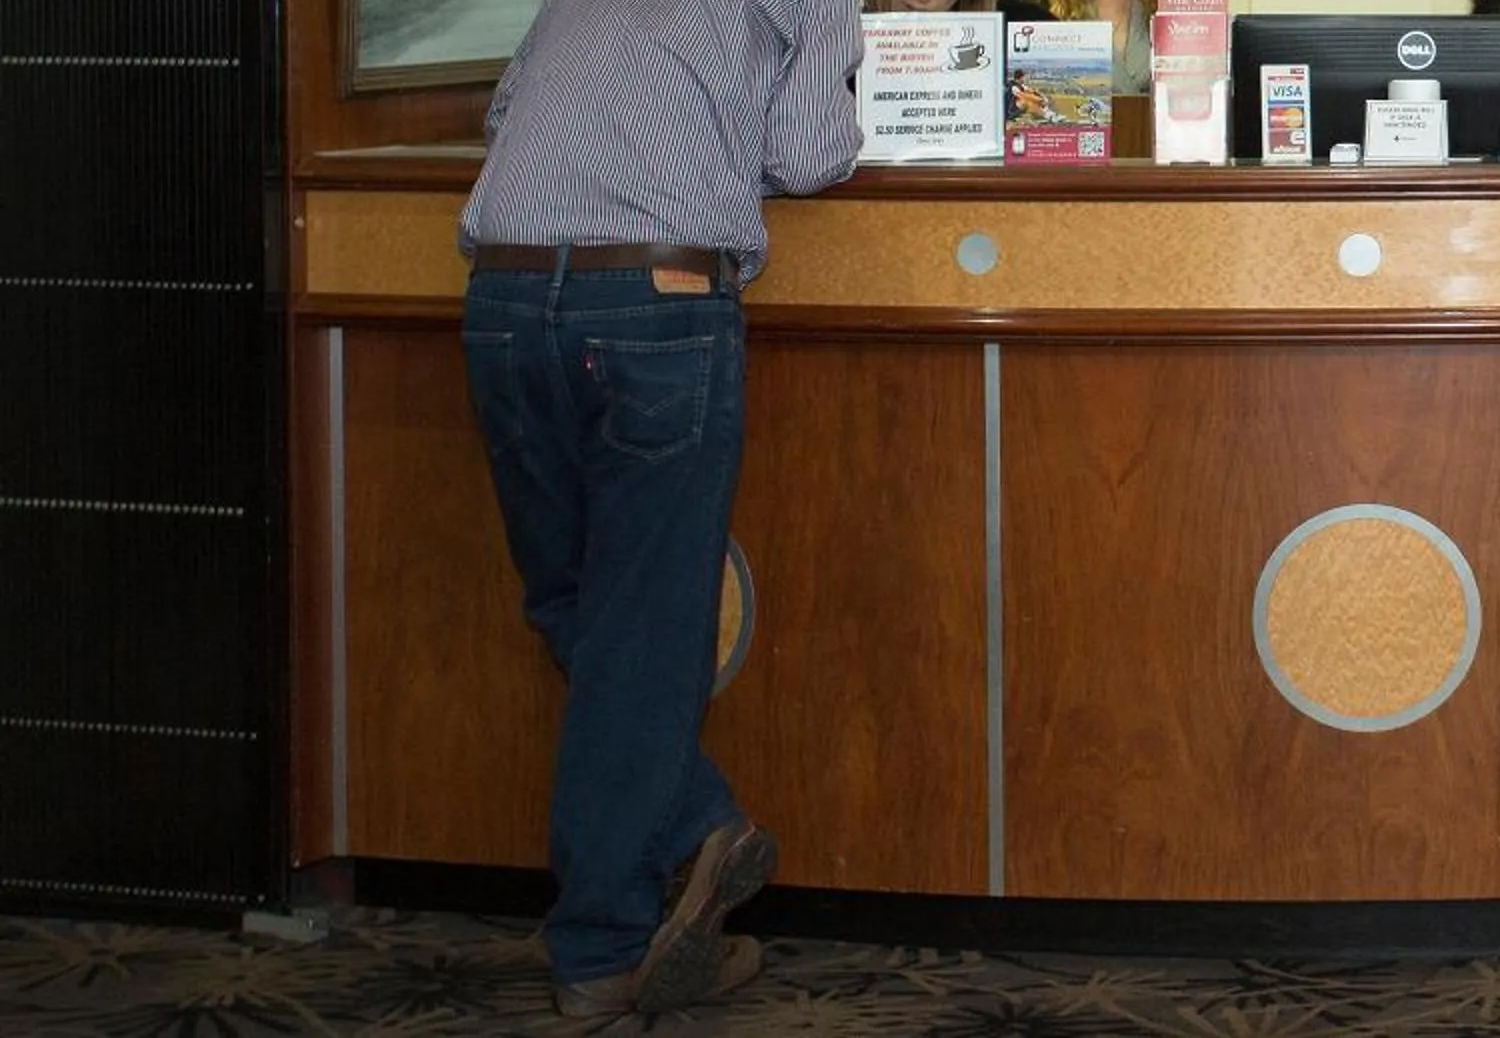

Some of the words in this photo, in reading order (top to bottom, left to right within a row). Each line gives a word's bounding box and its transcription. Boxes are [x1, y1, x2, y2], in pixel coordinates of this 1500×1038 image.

[1401, 45, 1432, 55] DELL
[876, 66, 902, 76] FROM
[873, 91, 908, 101] AMERICAN
[909, 90, 940, 100] EXPRESS
[1273, 85, 1303, 97] VISA
[901, 107, 937, 117] ACCEPTED
[895, 125, 923, 135] SERVICE
